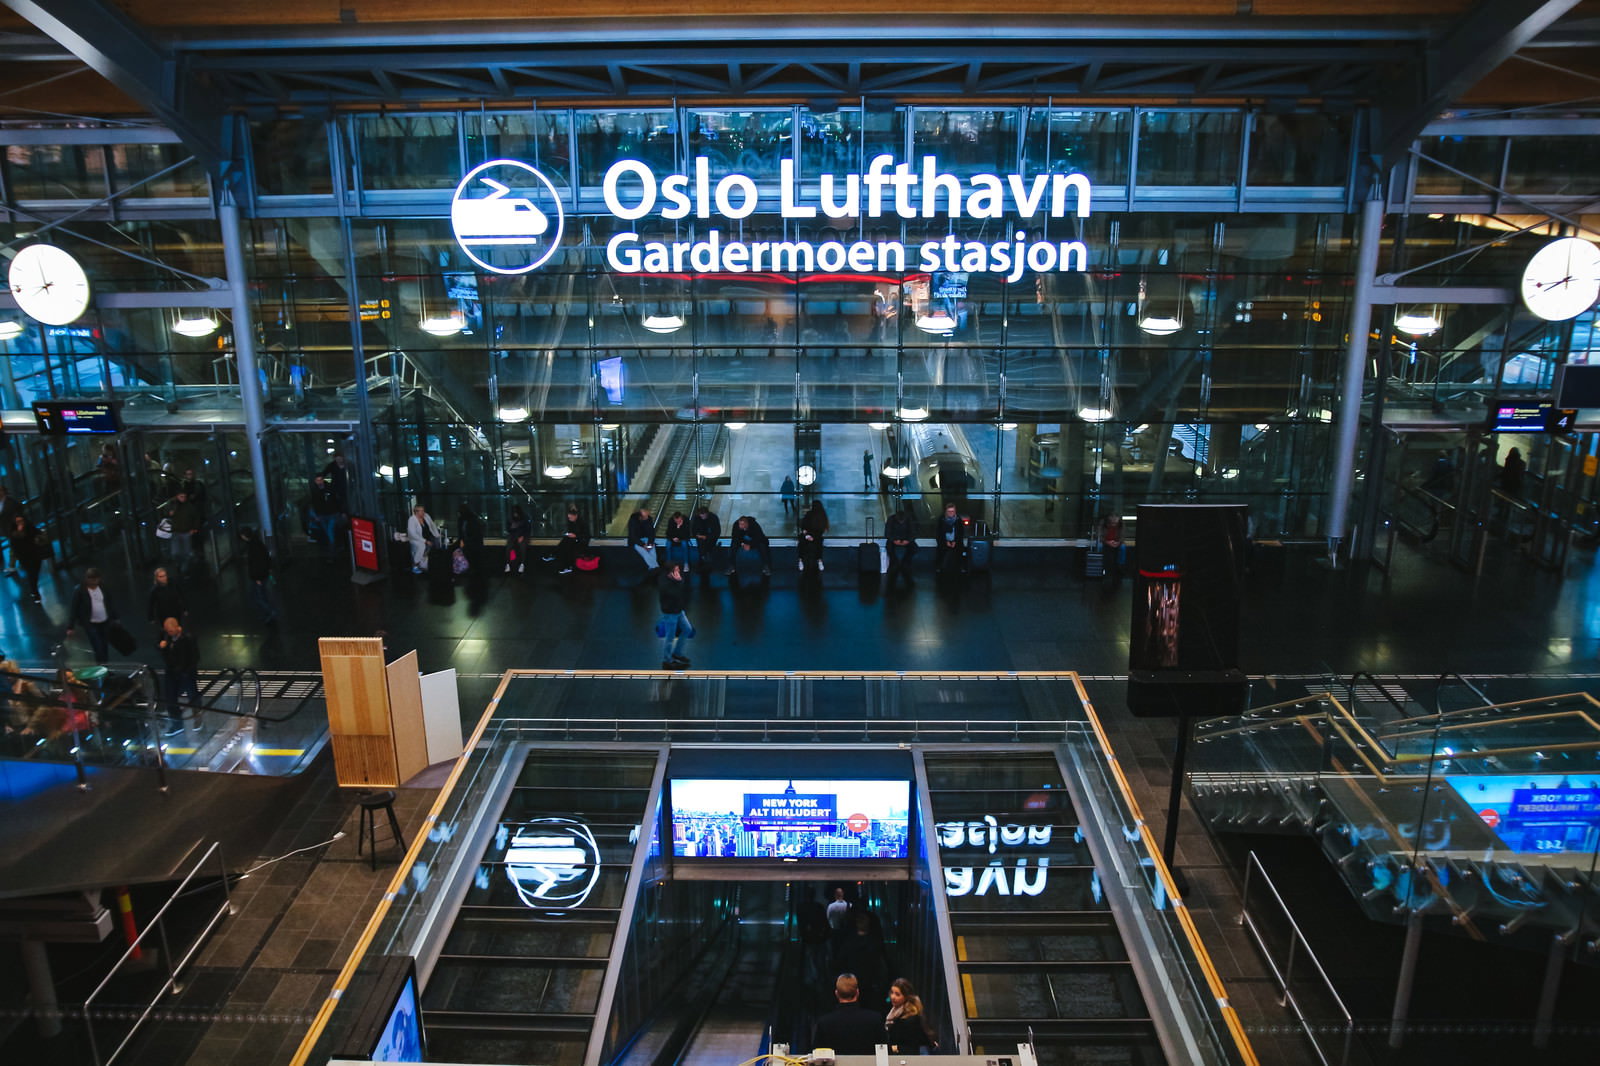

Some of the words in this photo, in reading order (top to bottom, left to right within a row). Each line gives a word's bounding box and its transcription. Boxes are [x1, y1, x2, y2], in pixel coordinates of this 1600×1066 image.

[603, 156, 758, 220] Oslo
[780, 154, 1091, 219] Lufthavn
[606, 230, 905, 273] Gardermoen
[919, 231, 1087, 283] stasjon
[1557, 416, 1567, 427] 4
[762, 799, 787, 807] NEW
[789, 799, 818, 807] YORK
[749, 808, 769, 816] ALT
[771, 808, 831, 816] INKLUDERT
[776, 843, 803, 853] SAS
